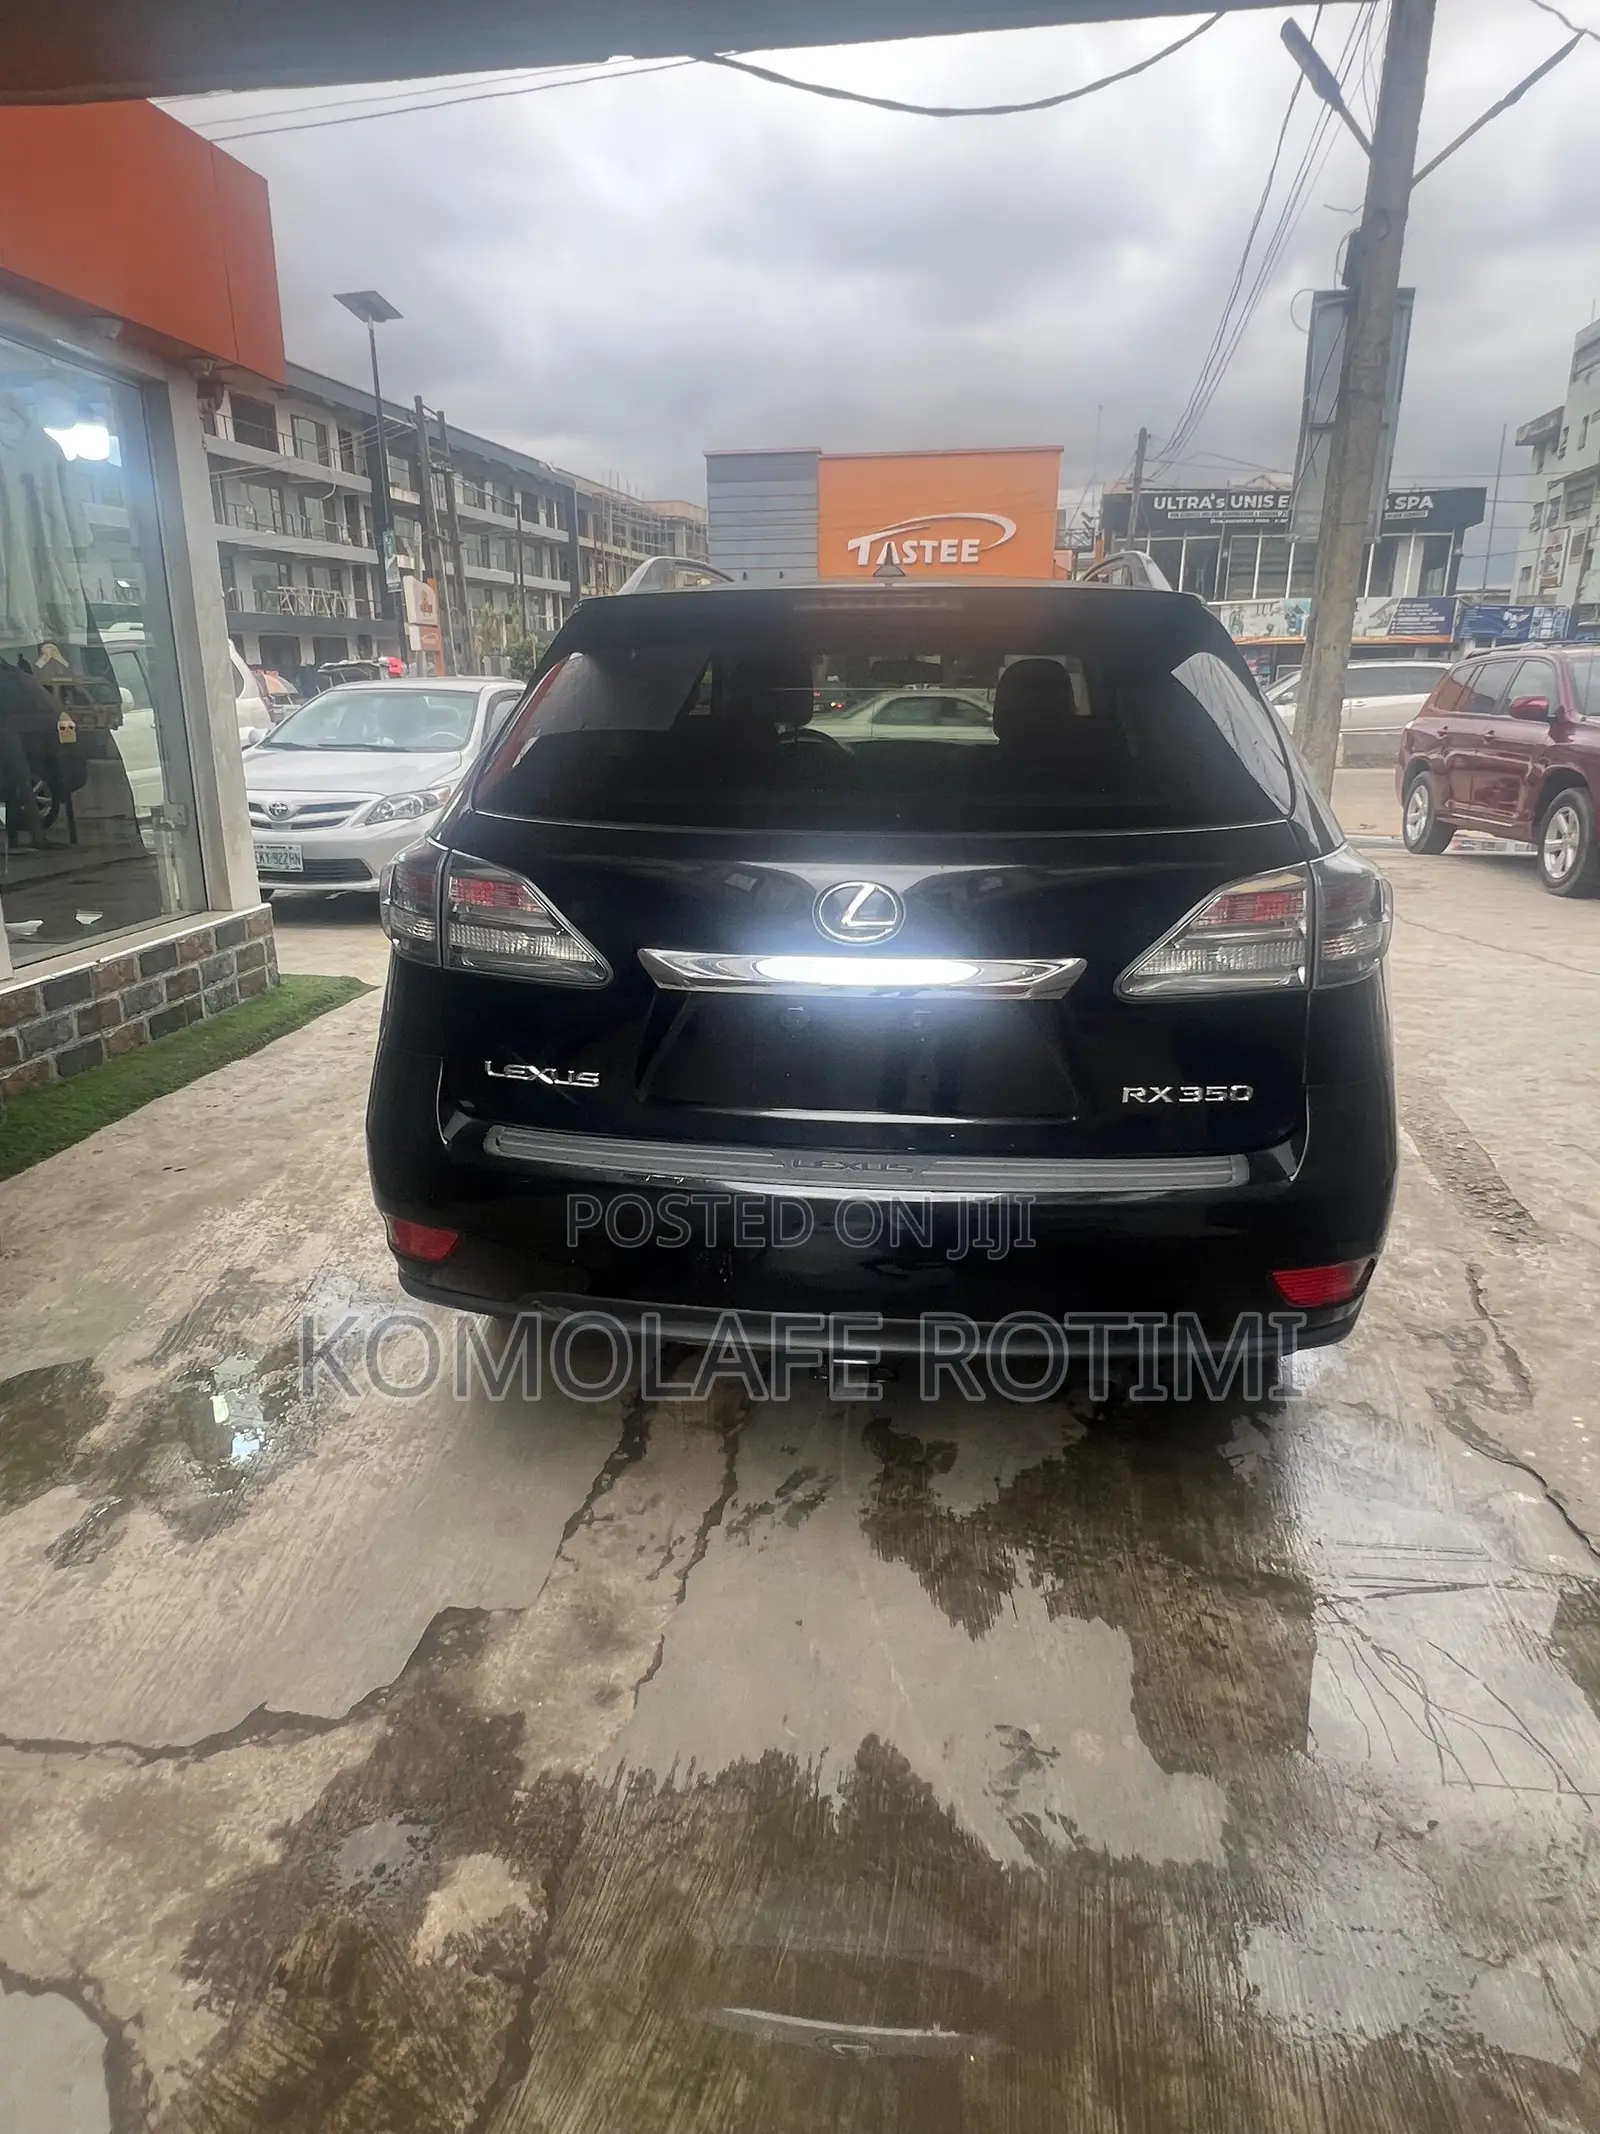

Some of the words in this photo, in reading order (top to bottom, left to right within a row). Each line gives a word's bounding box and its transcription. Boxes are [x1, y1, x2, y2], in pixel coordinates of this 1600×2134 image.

[1394, 495, 1434, 510] SPA
[847, 537, 981, 566] TASTEE
[485, 1060, 600, 1088] LEXUS
[1121, 1085, 1174, 1104] RX
[1178, 1084, 1254, 1103] 350
[791, 1158, 915, 1180] LEXUS
